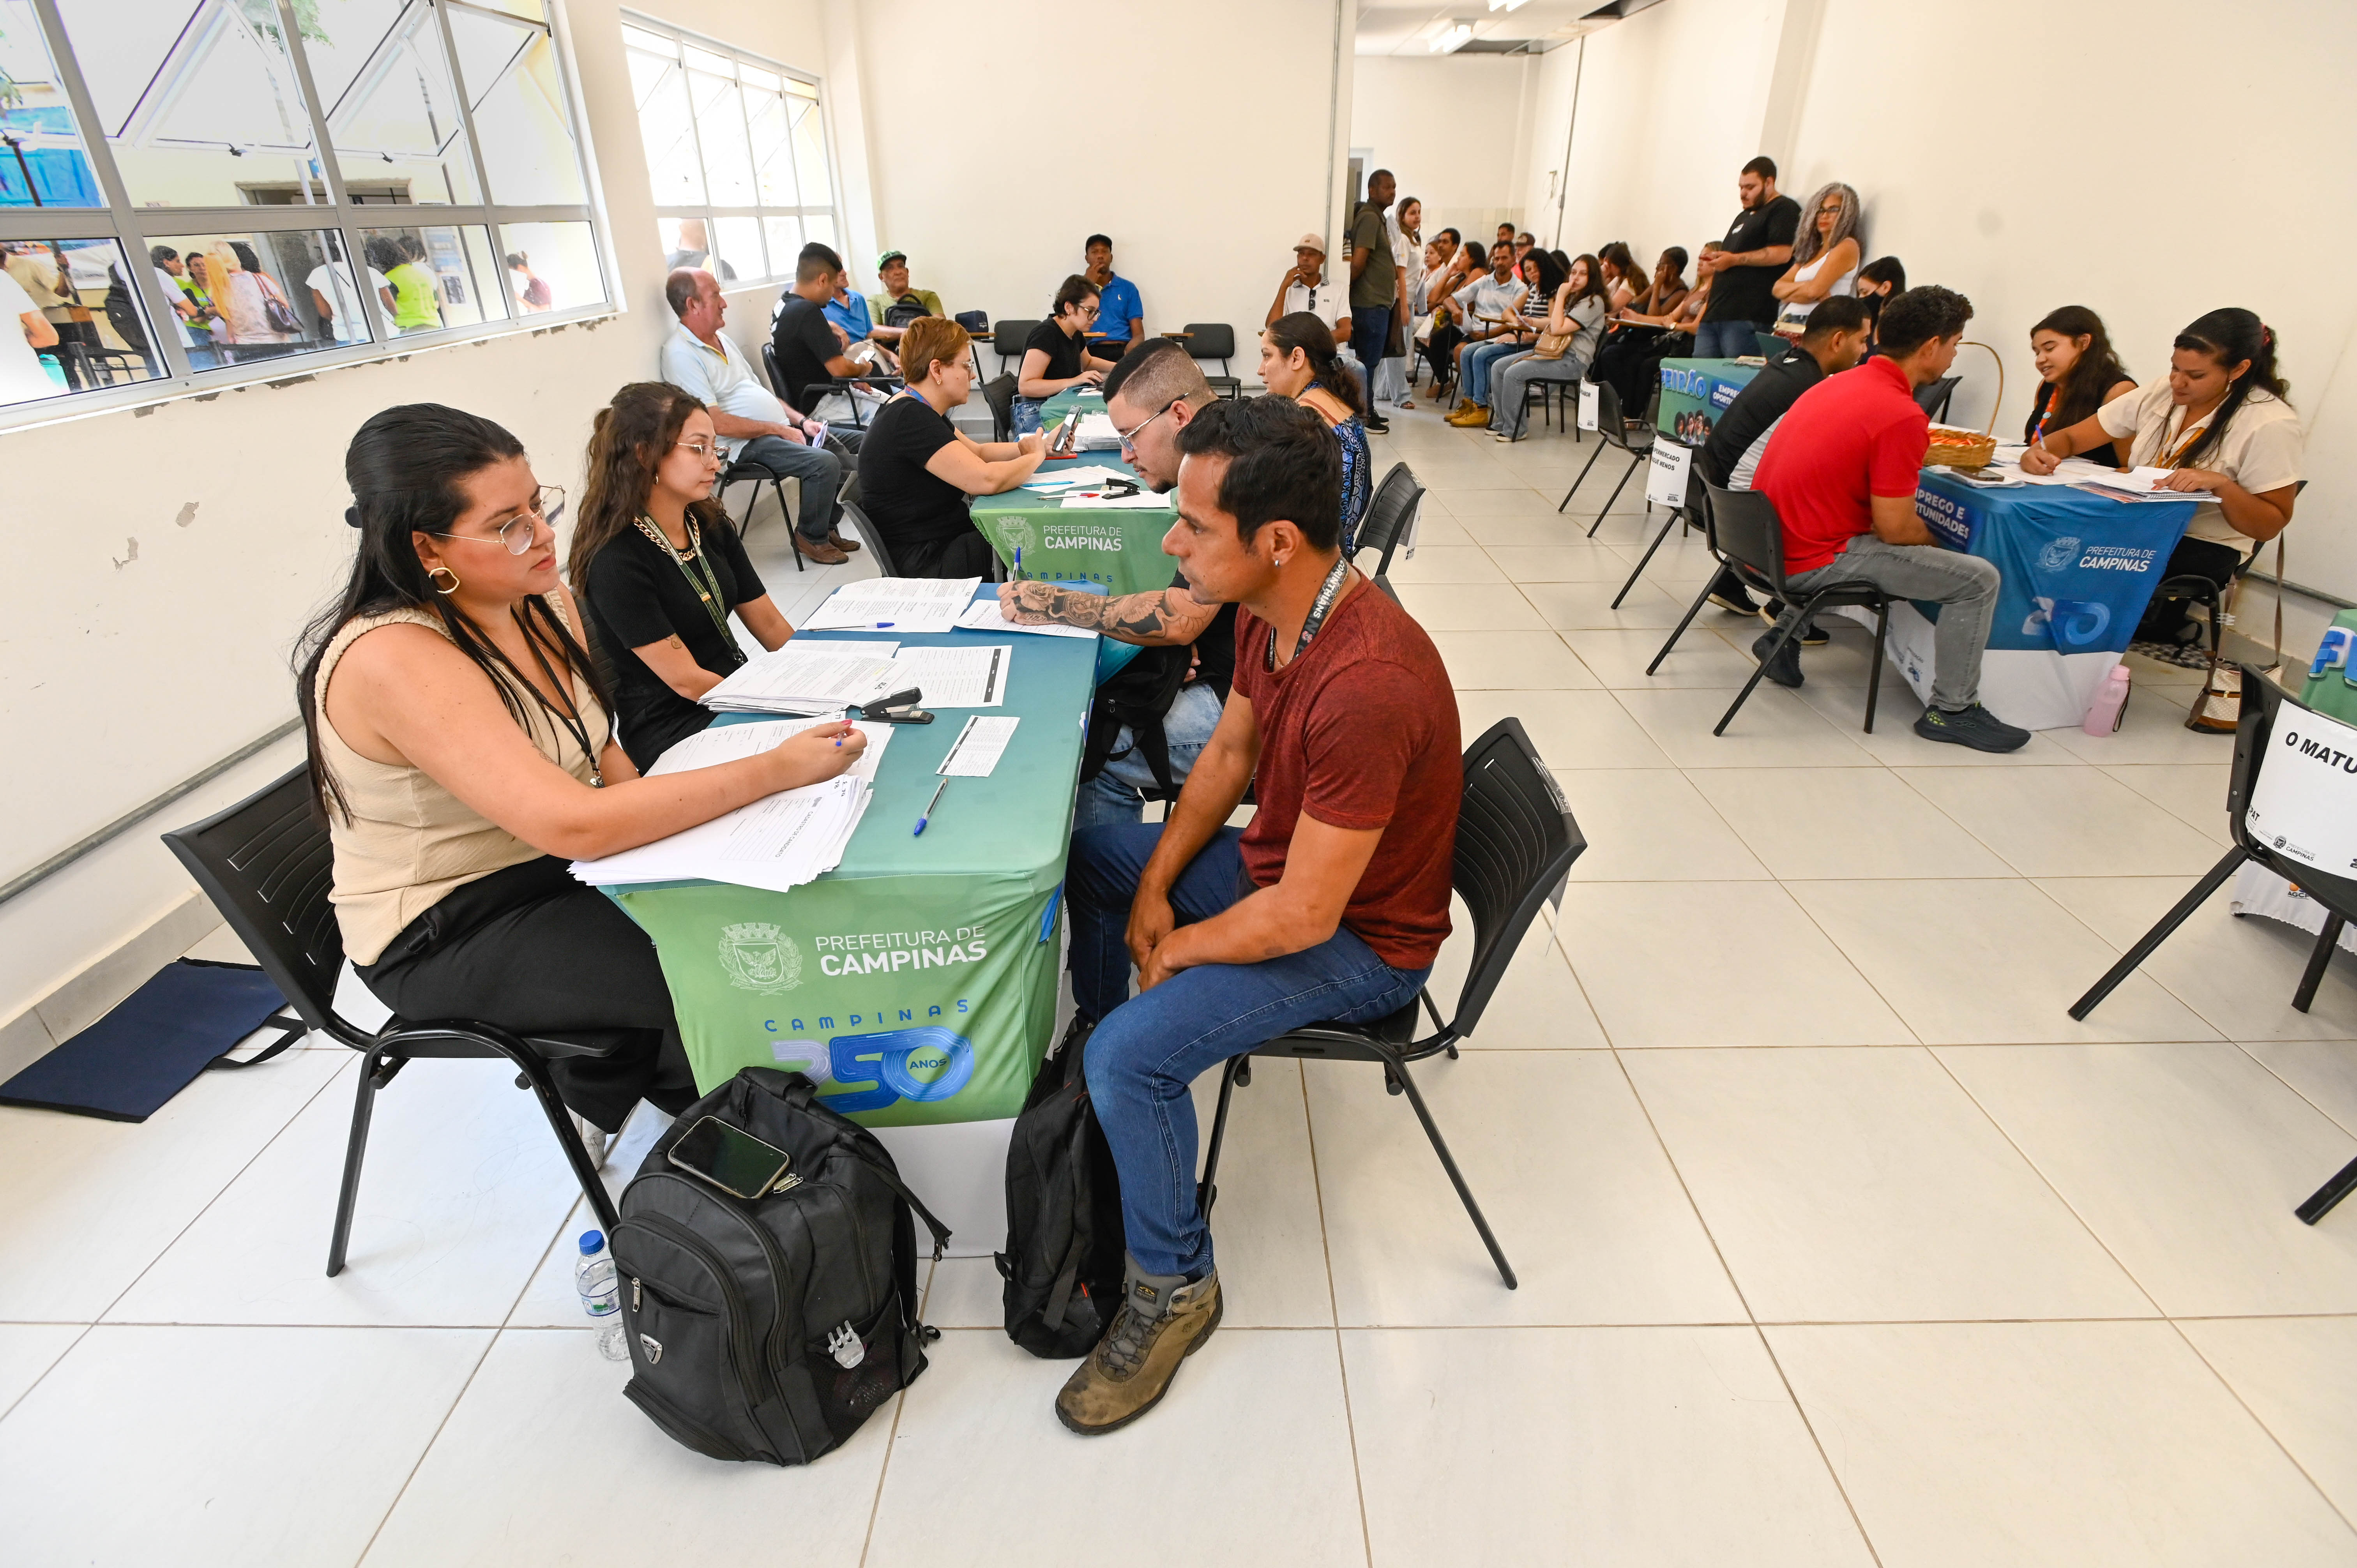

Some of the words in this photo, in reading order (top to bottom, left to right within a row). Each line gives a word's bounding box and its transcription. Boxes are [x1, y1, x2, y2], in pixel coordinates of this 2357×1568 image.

[1653, 448, 1680, 462] PERMERCADO
[1659, 461, 1675, 471] MENOS
[1915, 488, 1954, 514] PREGO
[1956, 507, 1965, 520] E
[1043, 525, 1107, 536] PREFEITURA
[1109, 526, 1122, 537] DE
[1044, 536, 1122, 551] CAMPINAS
[2085, 546, 2140, 558] PREFEITURA
[2141, 549, 2157, 560] DE
[2079, 556, 2150, 572] CAMPINAS
[1313, 560, 1345, 618] CORINTHIANS
[2286, 732, 2298, 746] O
[2299, 738, 2357, 774] MATU
[797, 811, 813, 831] CADASTRO
[775, 836, 795, 858] CANDIDATO
[2286, 846, 2315, 861] CAMPINAS
[2288, 842, 2310, 855] PREFEITURA
[815, 929, 951, 952] PREFEITURA
[956, 925, 986, 941] DE
[820, 940, 987, 976] CAMPINAS
[764, 999, 968, 1032] CAMPINAS
[909, 1058, 947, 1070] ANOS
